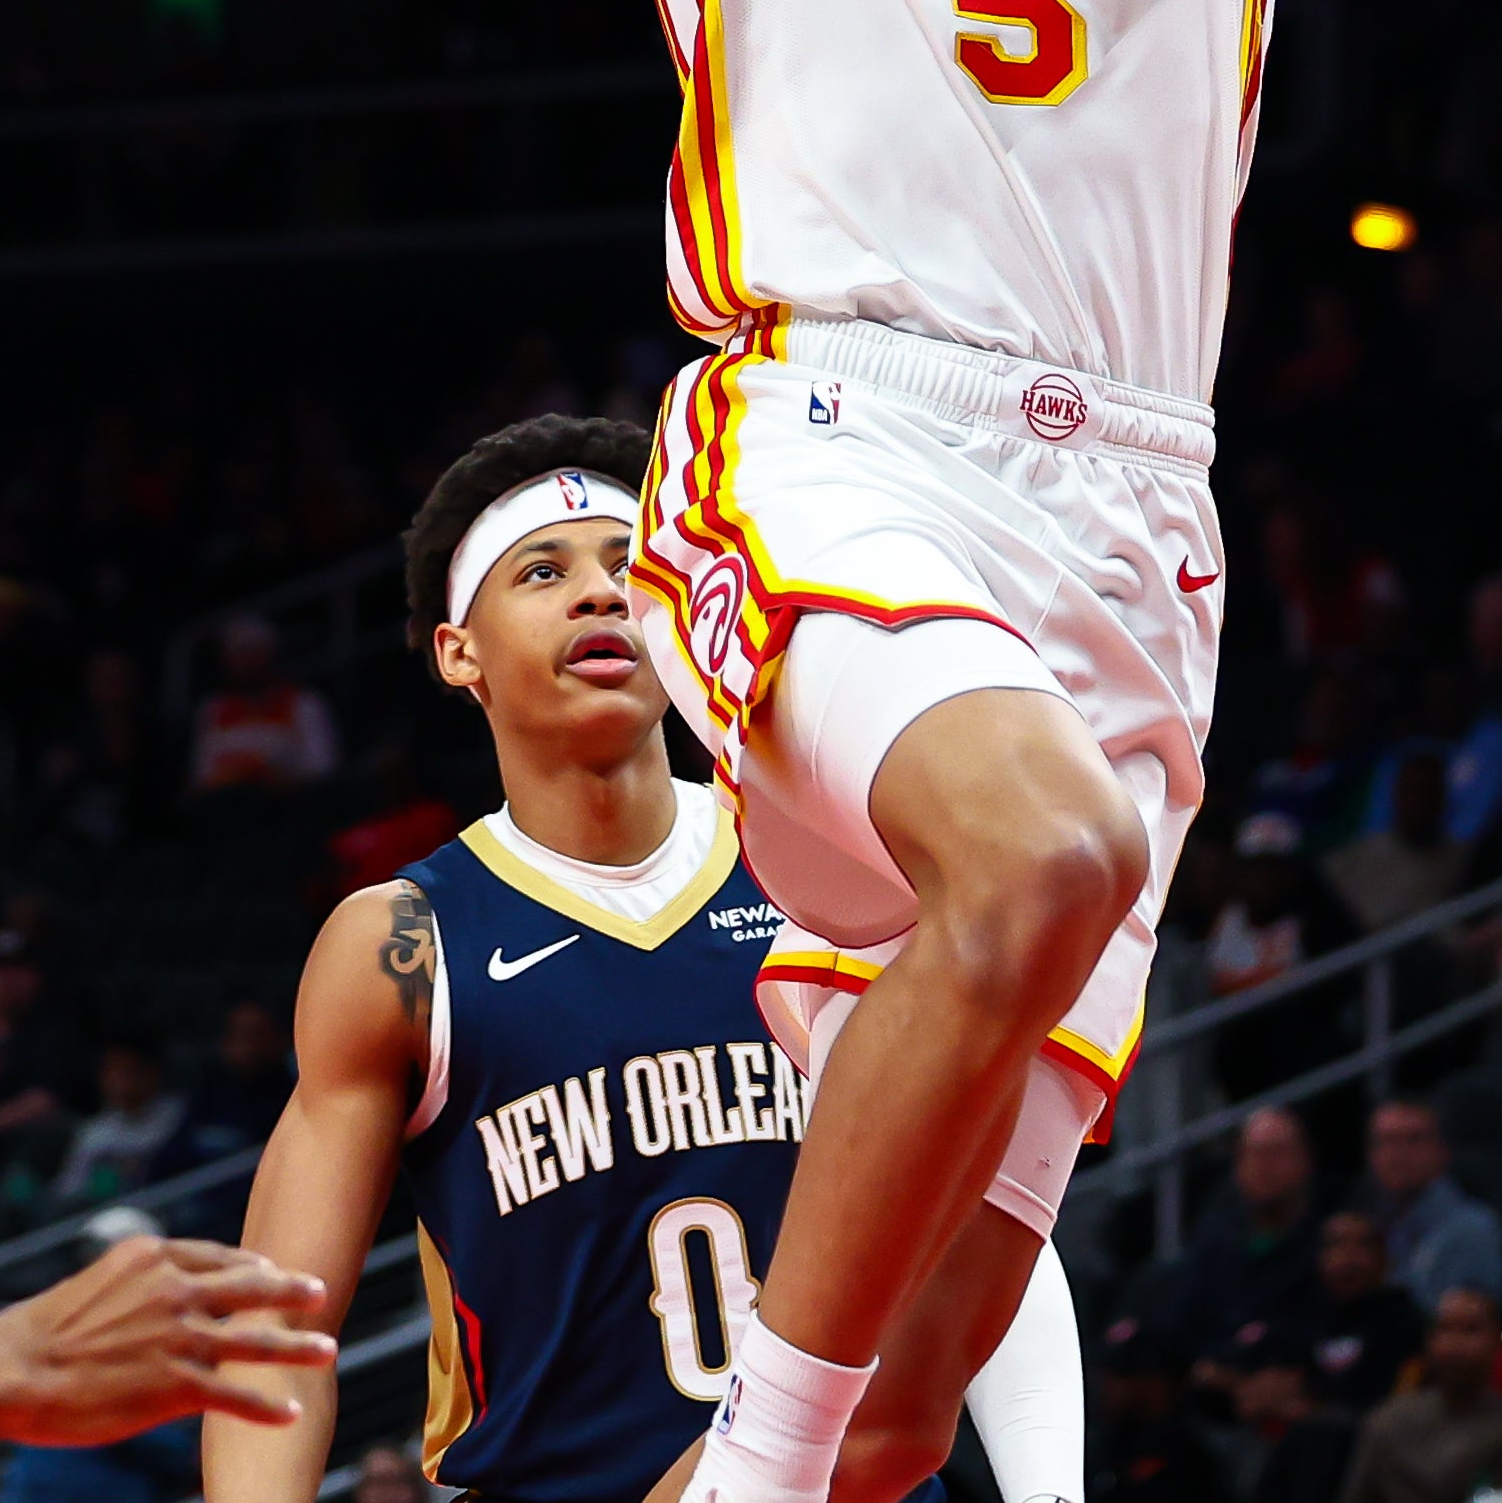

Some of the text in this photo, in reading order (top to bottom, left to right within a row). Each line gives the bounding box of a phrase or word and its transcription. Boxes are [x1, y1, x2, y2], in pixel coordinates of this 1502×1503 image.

[1019, 389, 1088, 424] HAWKS
[708, 902, 784, 930] NEWA
[731, 924, 781, 942] GARA
[475, 1041, 809, 1216] NEW ORLEA
[648, 1196, 761, 1402] 0
